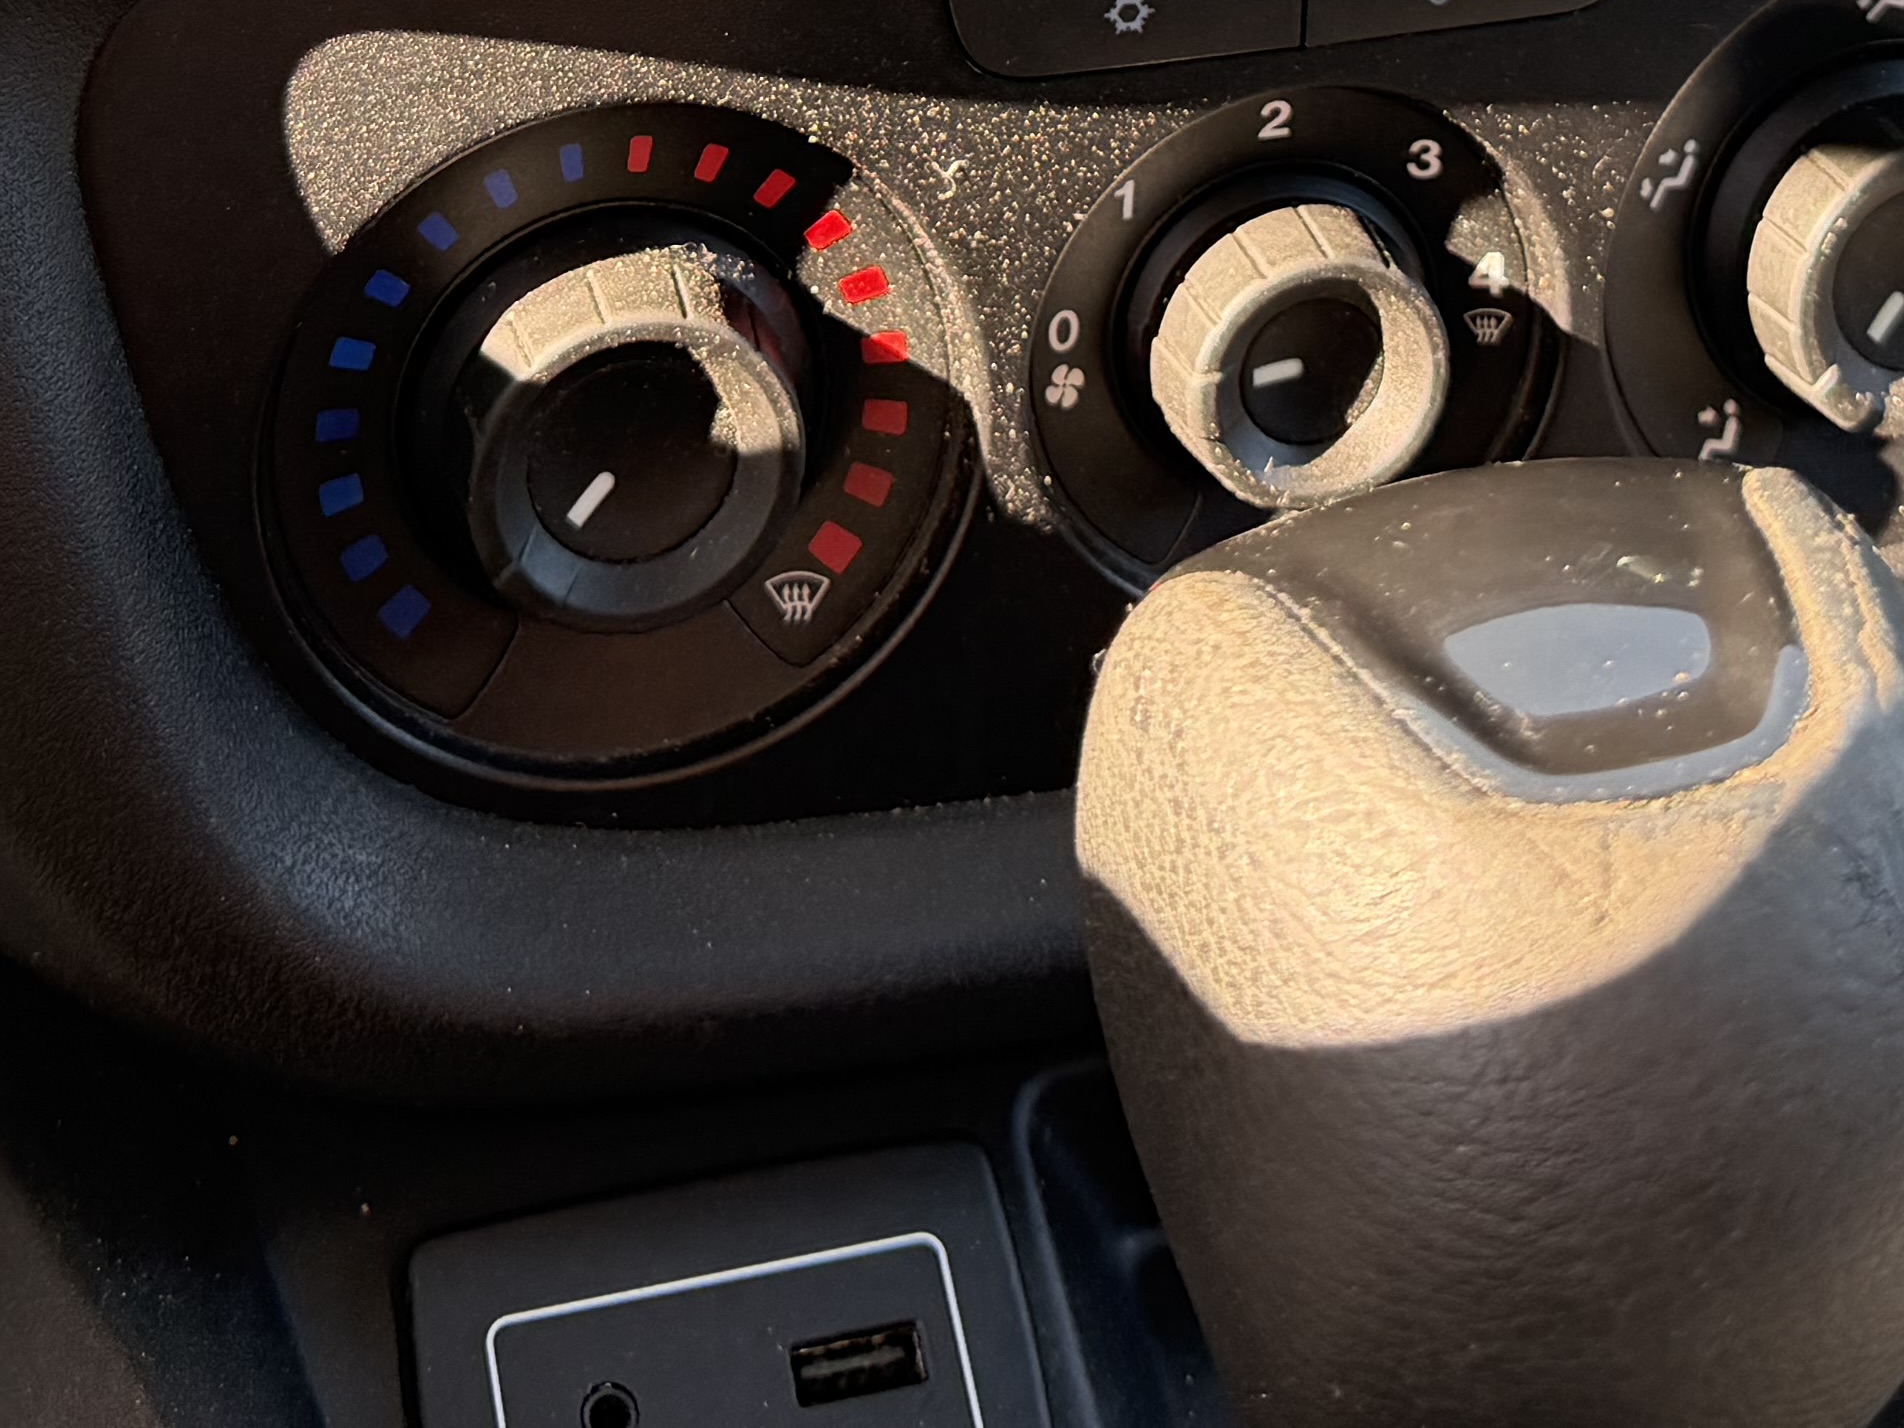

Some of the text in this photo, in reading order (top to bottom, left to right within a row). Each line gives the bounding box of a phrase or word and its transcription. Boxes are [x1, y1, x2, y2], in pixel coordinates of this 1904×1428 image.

[1257, 99, 1294, 141] 2
[1405, 138, 1445, 180] 3
[1112, 177, 1138, 221] 1
[1467, 249, 1511, 296] 4
[1047, 309, 1081, 354] 0
